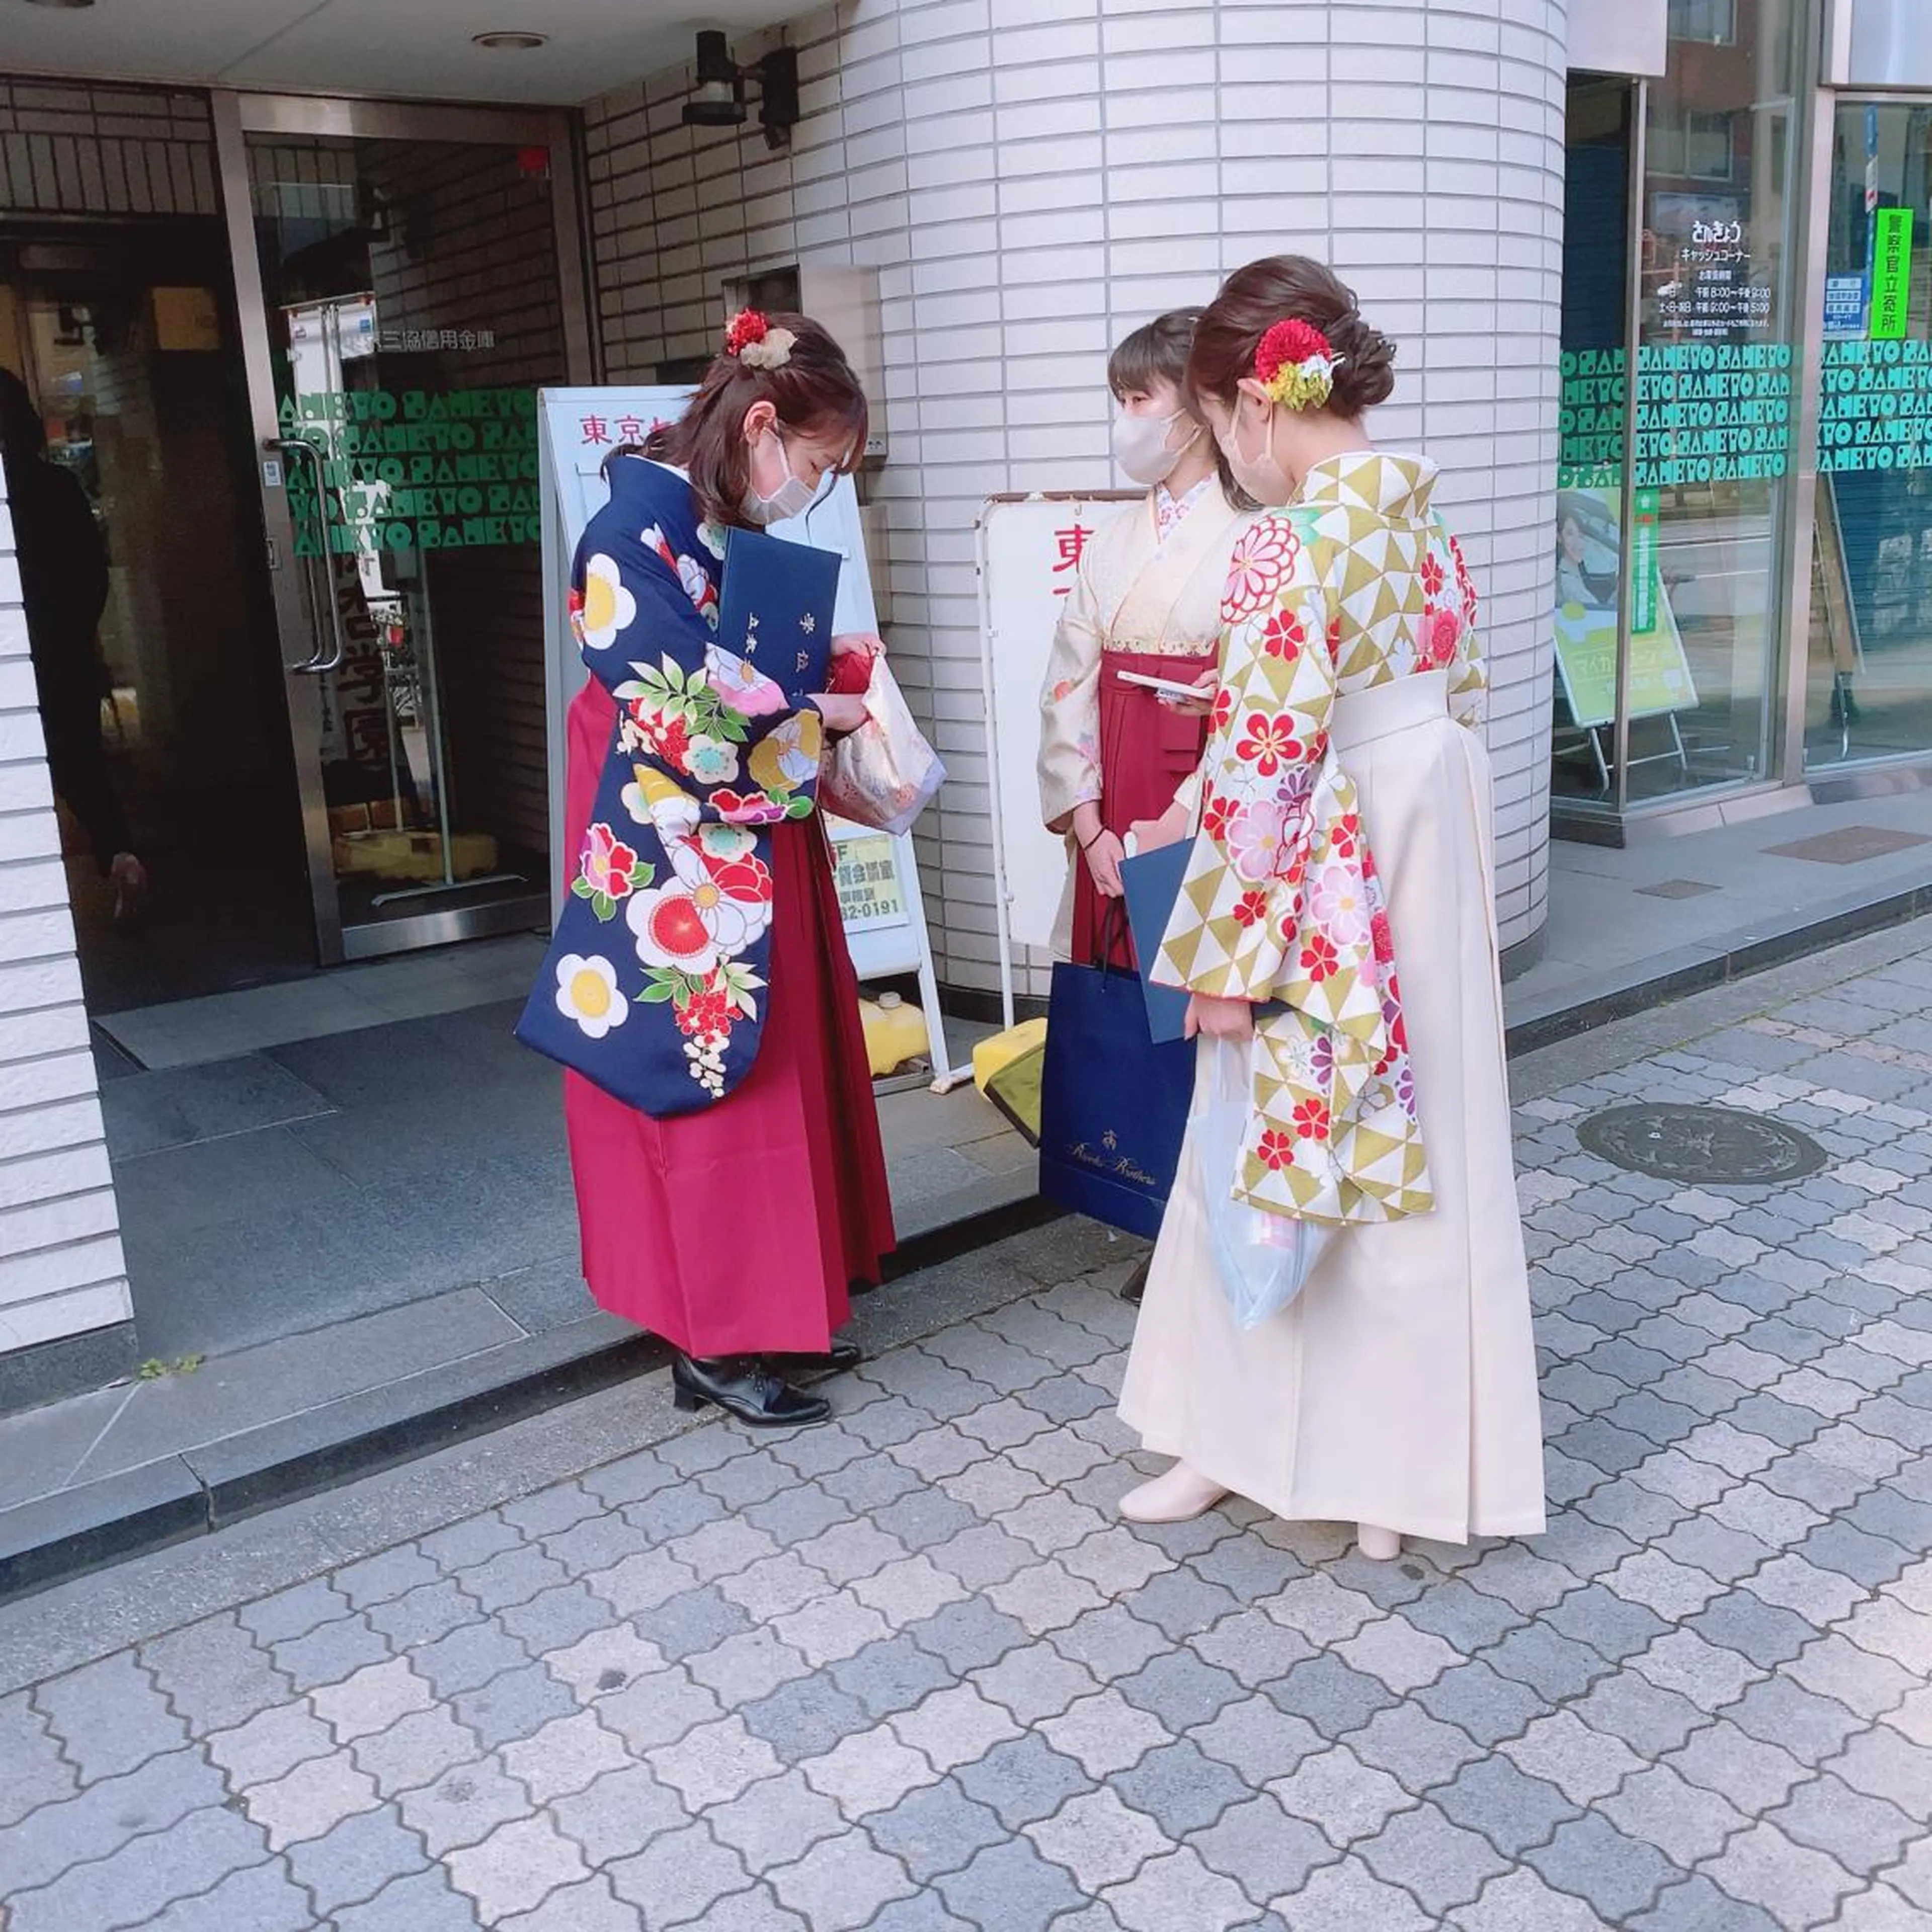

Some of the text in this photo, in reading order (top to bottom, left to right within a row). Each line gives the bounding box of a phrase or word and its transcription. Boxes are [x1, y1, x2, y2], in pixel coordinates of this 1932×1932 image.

[1692, 220, 1741, 243] さんきょう
[1681, 248, 1752, 263] キャッシュコーナー
[1881, 214, 1903, 332] 警察官立寄所
